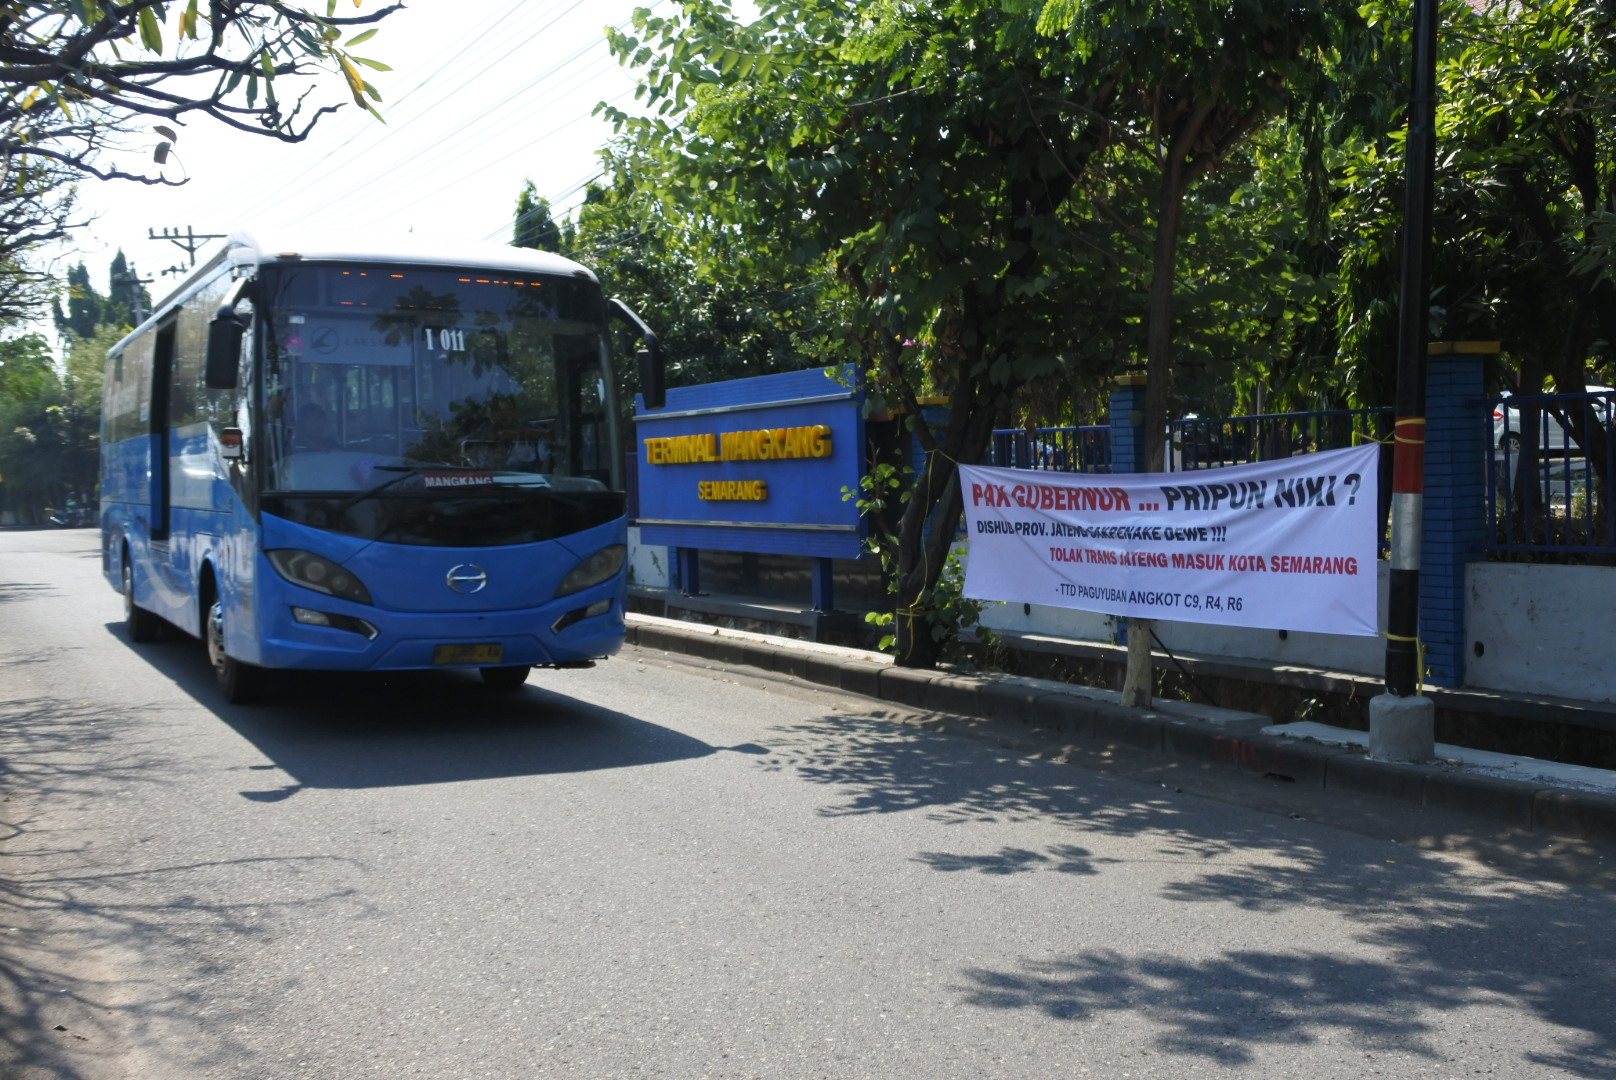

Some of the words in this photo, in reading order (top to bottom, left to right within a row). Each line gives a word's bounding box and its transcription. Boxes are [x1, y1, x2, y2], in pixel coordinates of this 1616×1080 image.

[440, 329, 465, 351] 011
[644, 433, 719, 464] TERMINAL
[720, 424, 832, 461] MANGKANG
[424, 476, 492, 487] MANGKANG
[698, 480, 767, 500] SEMARANG
[972, 483, 1011, 508] PAK
[1011, 484, 1131, 511] GUBERNUR
[1160, 480, 1267, 511] PRIPUN
[1273, 475, 1336, 508] NIKI
[1343, 473, 1362, 506] ?
[977, 520, 1014, 535] DISHUB
[1015, 521, 1049, 537] PROV.
[1050, 523, 1087, 538] JATENG
[1164, 526, 1208, 542] DEWE
[1211, 526, 1227, 542] !!!
[1050, 547, 1083, 563] TOLAK
[1084, 548, 1118, 565] TRANS
[1120, 551, 1168, 568] JATENG
[1172, 553, 1225, 570] MASUK
[1228, 555, 1267, 572] KOTA
[1270, 555, 1358, 575] SEMARANG
[1078, 585, 1127, 603] PAGUYUBAN
[1128, 591, 1181, 607] ANGKOT
[1184, 594, 1202, 611] C9,
[1206, 595, 1224, 612] R4,
[1227, 597, 1243, 611] R6
